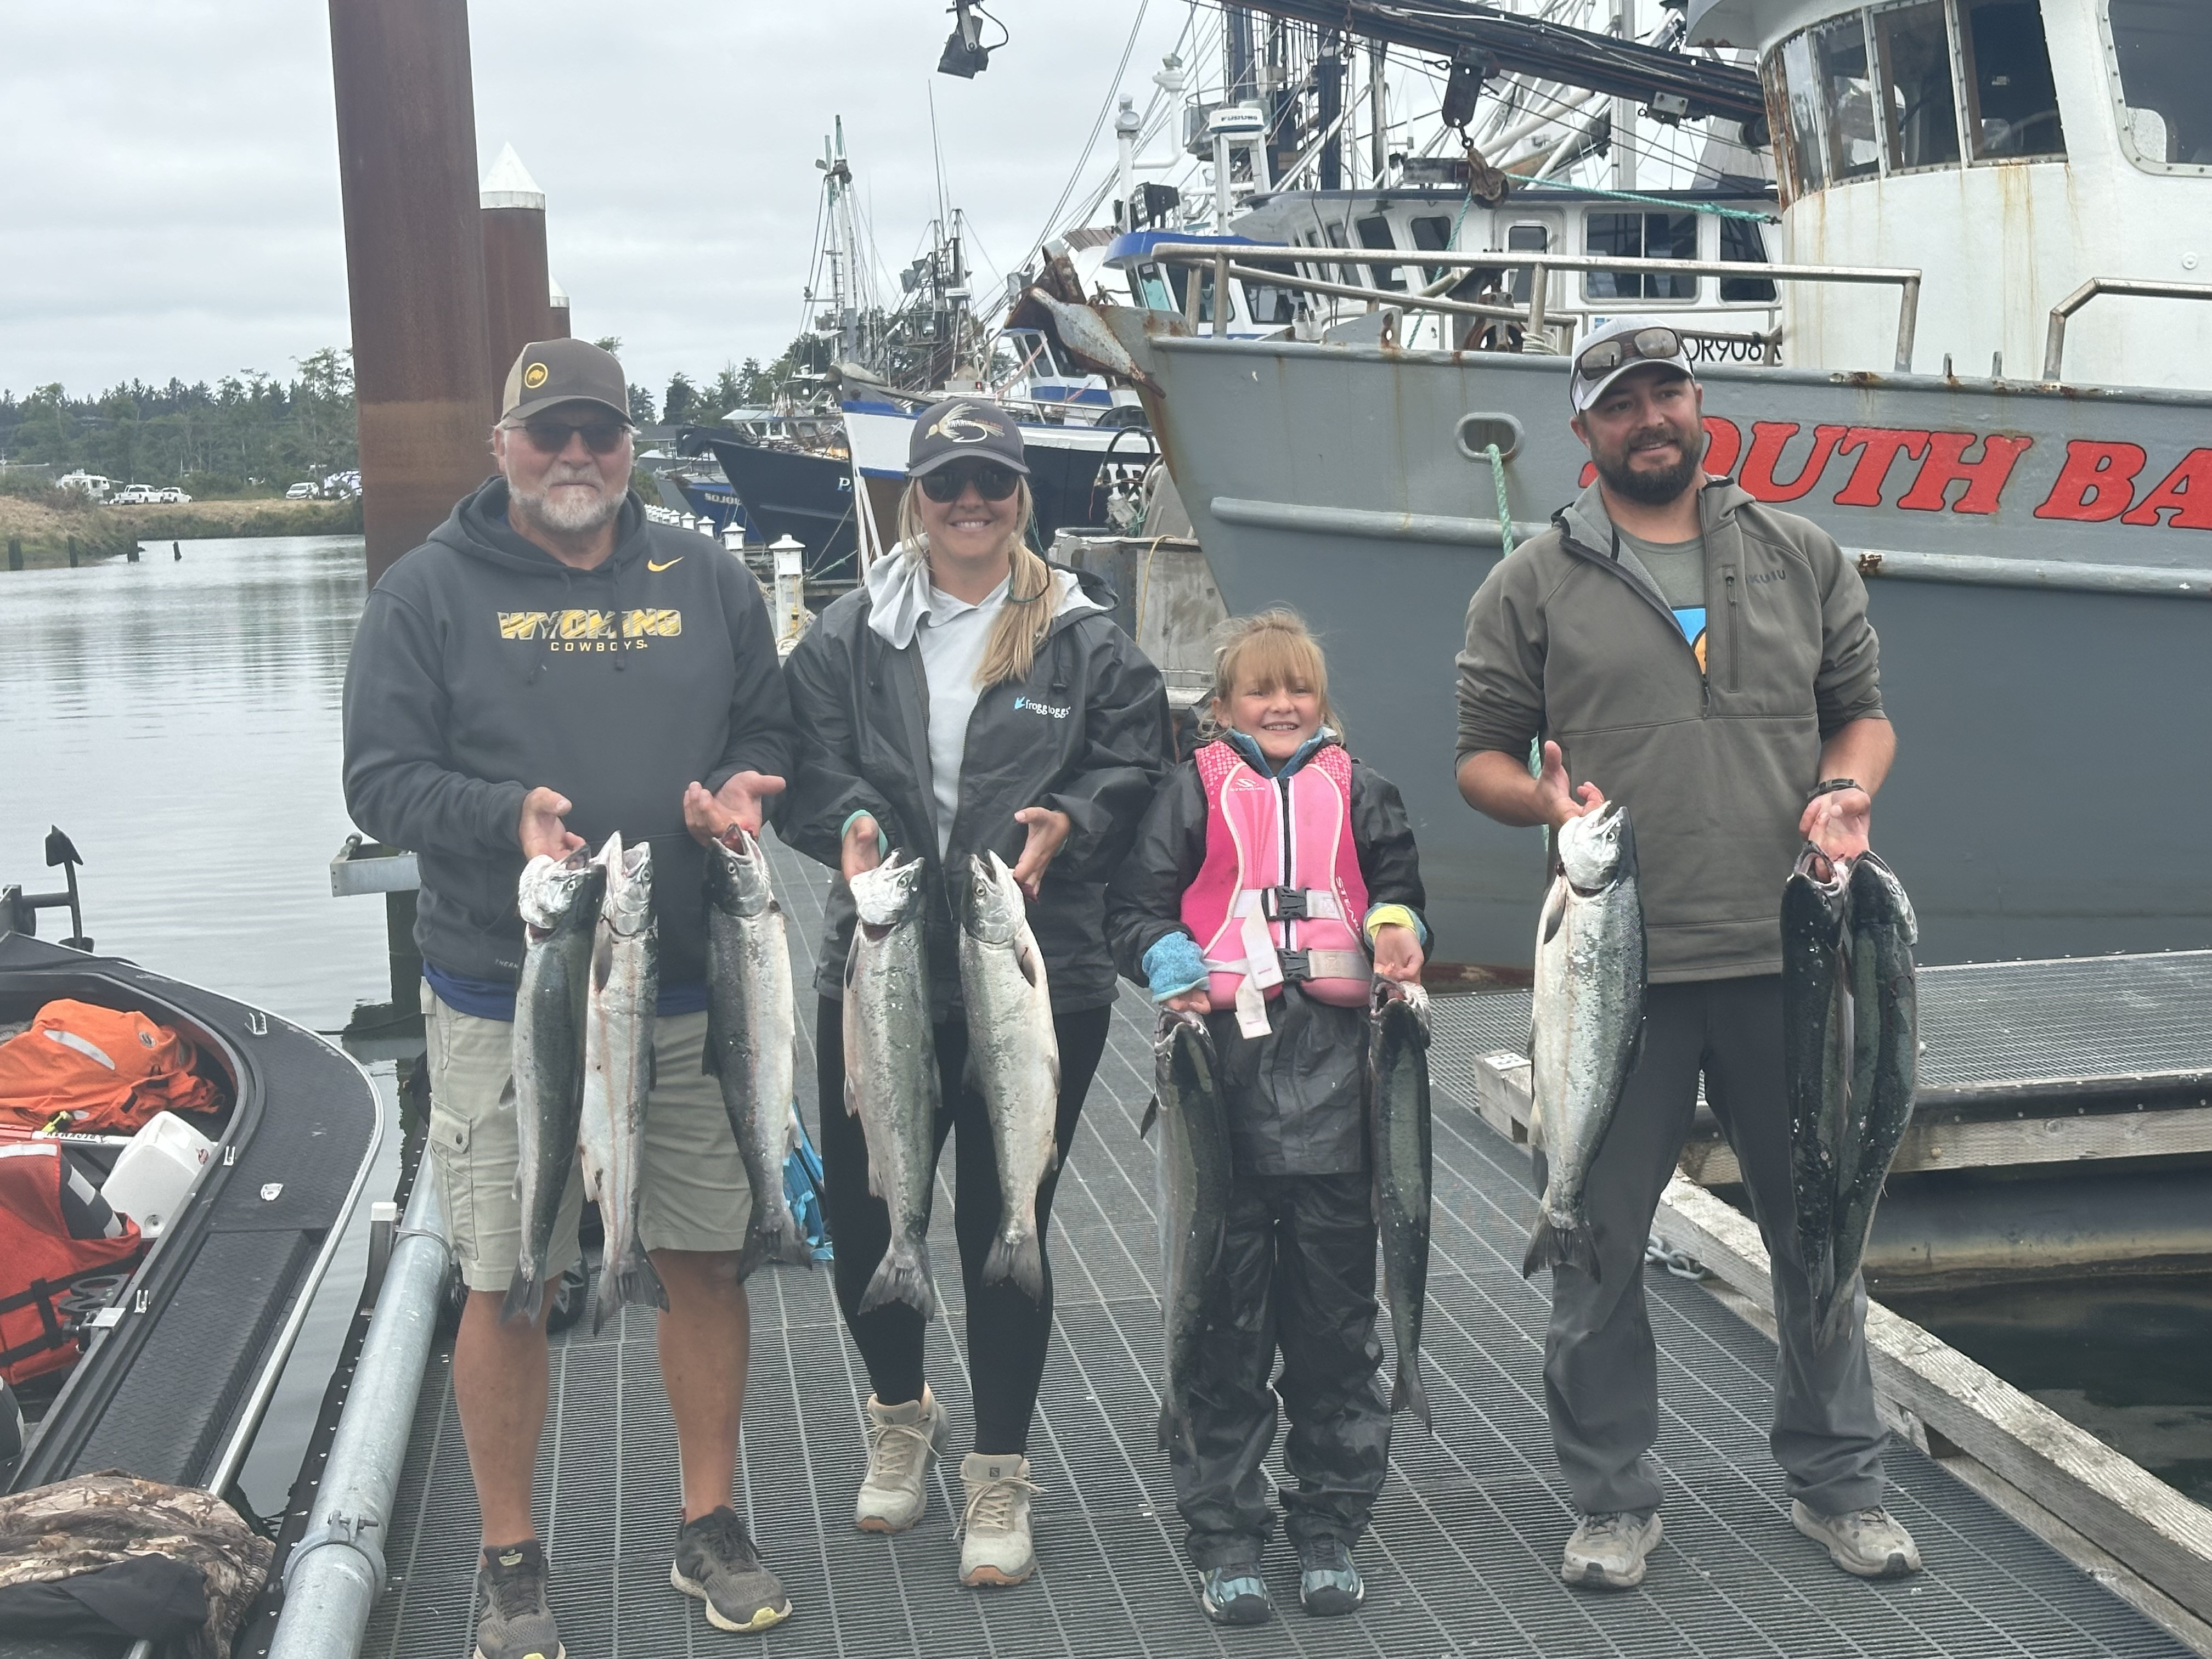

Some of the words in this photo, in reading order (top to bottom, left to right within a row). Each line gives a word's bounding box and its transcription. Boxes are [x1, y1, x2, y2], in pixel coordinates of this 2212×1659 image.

[1578, 416, 2033, 516] OUTH
[837, 477, 852, 492] P
[496, 608, 682, 640] WYOMING
[550, 639, 644, 652] COWBOYS
[1025, 699, 1048, 715] frogg
